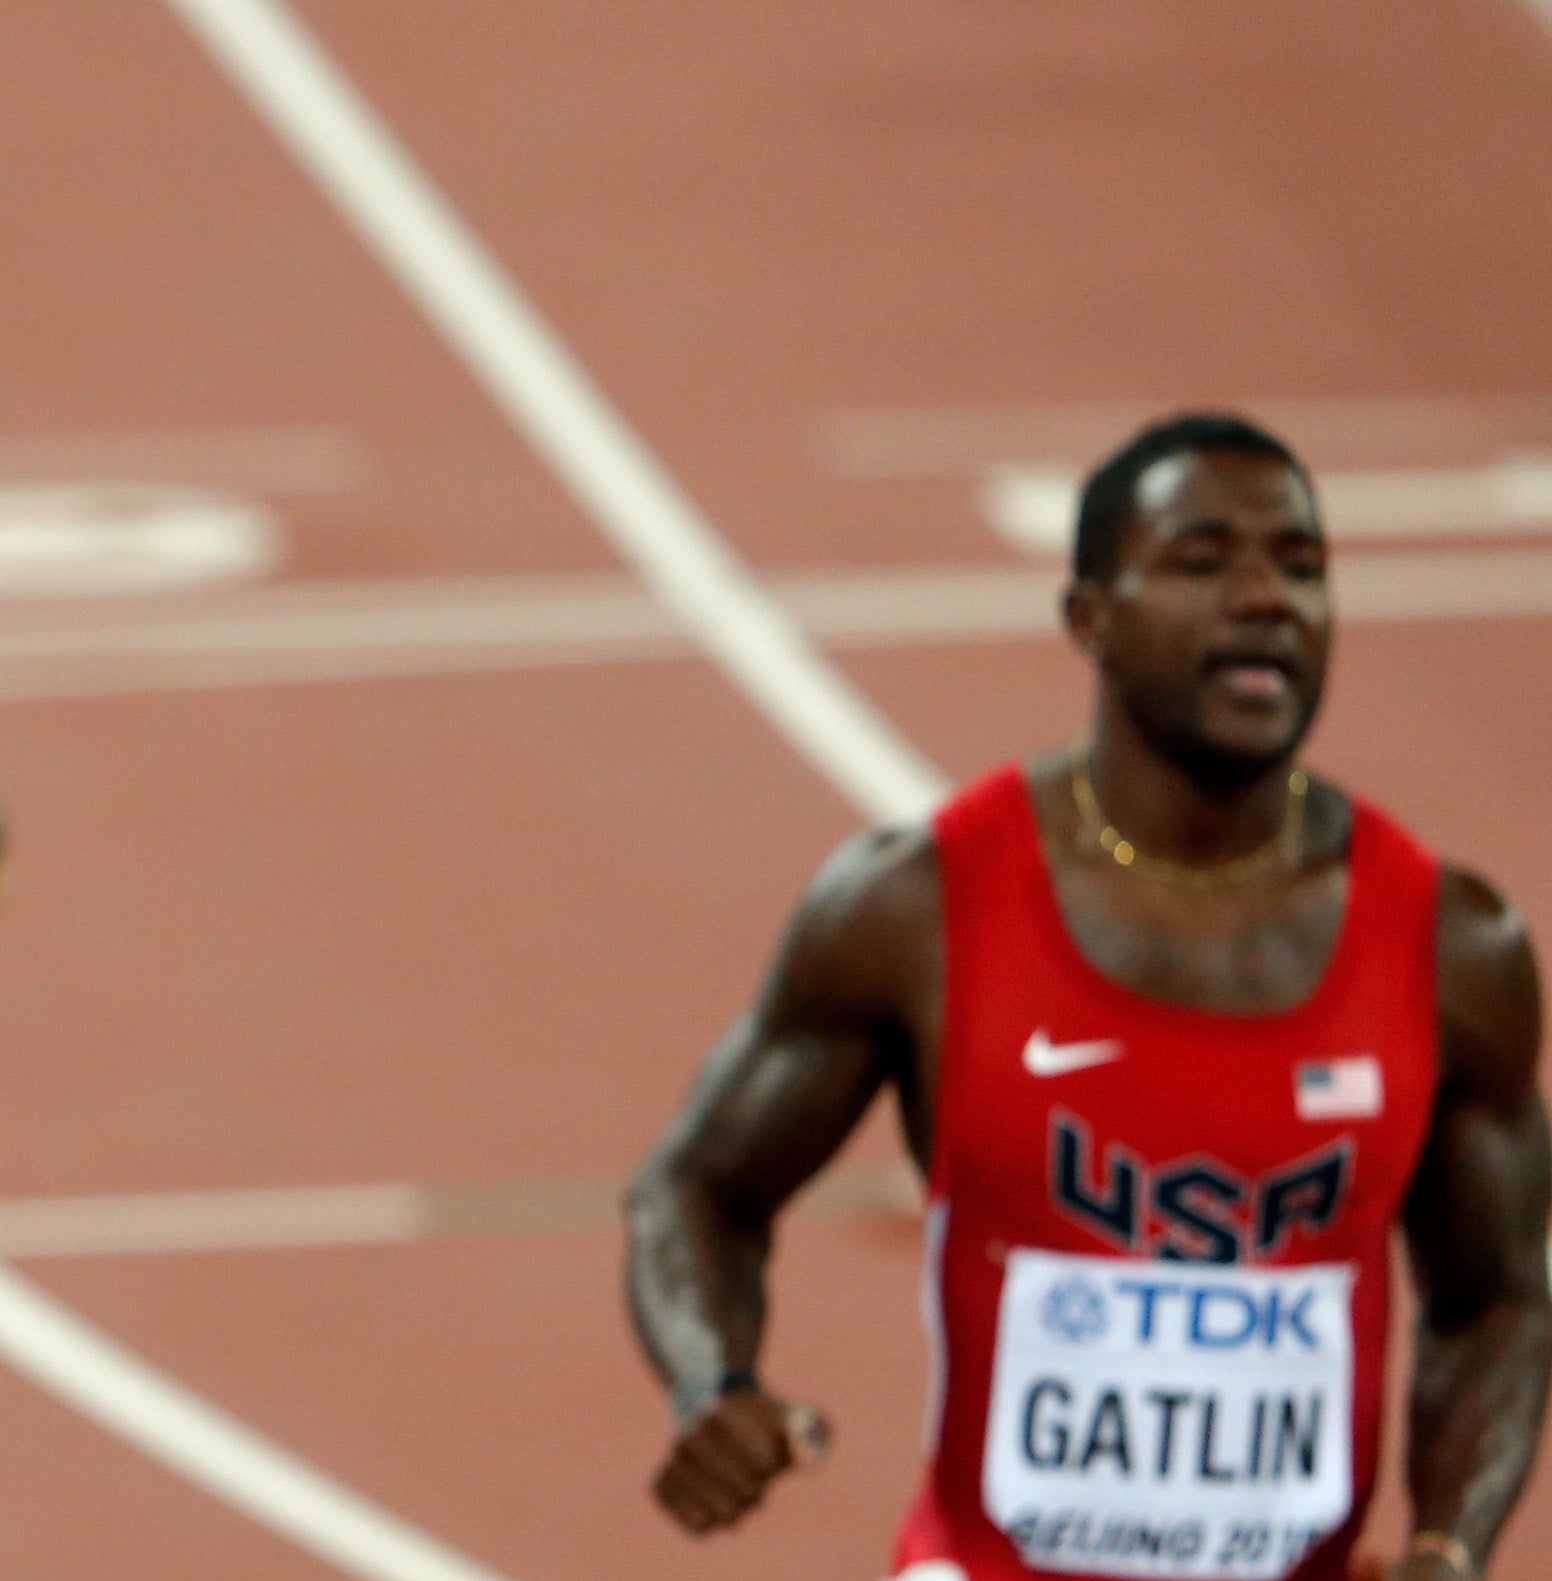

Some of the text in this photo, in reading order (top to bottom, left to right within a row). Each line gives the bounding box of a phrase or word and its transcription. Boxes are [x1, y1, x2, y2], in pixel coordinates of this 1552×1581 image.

[1049, 1109, 1355, 1267] USA
[1111, 1278, 1320, 1352] TDK
[1021, 1375, 1324, 1484] GATLIN
[1006, 1506, 1206, 1563] BEIJING
